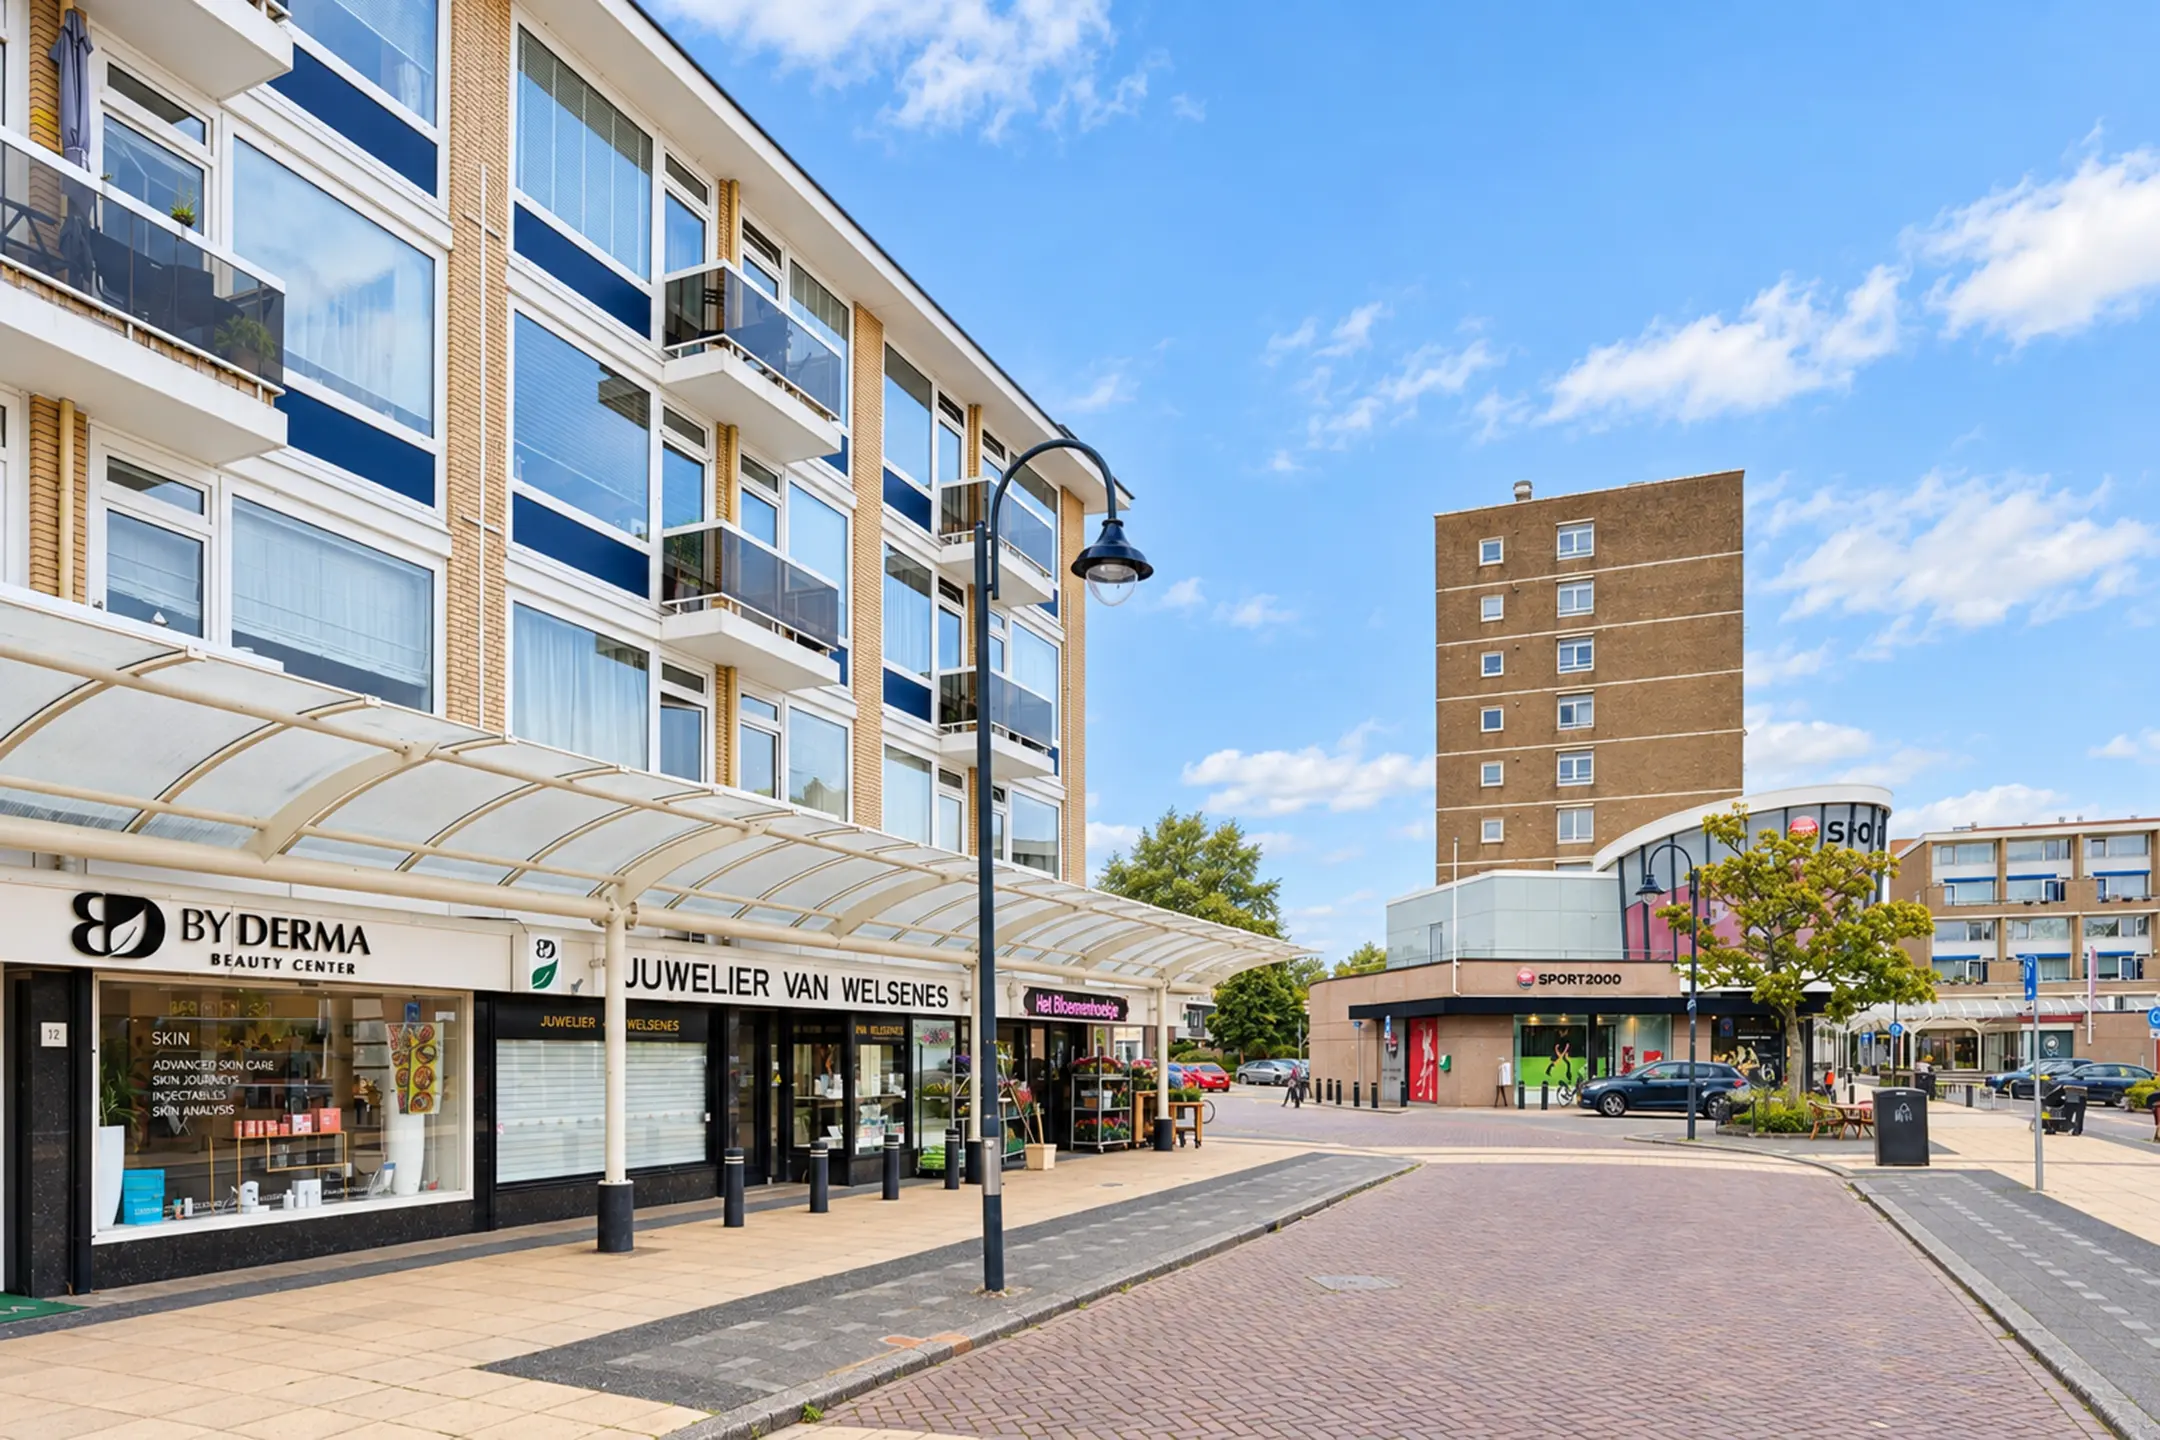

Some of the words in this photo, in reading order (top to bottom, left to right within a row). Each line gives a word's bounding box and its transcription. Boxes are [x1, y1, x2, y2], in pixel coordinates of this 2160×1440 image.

[181, 908, 231, 943] BY
[238, 913, 371, 956] DERMA
[211, 953, 283, 970] BEAUTY
[292, 958, 356, 975] CENTER
[626, 957, 770, 998] JUWELIER
[783, 971, 829, 1001] VAN
[842, 977, 949, 1009] WELSENES
[1538, 973, 1622, 986] SPORT2000
[540, 1016, 596, 1029] JUWELIER
[627, 1018, 680, 1032] WELSENES
[152, 1031, 190, 1046] SKIN
[152, 1060, 216, 1071] ADVANCED
[218, 1060, 244, 1071] SKIN
[246, 1060, 274, 1071] CARE
[152, 1074, 179, 1086] SKIN
[152, 1106, 179, 1117] SKIN
[183, 1104, 235, 1116] ANALYSIS
